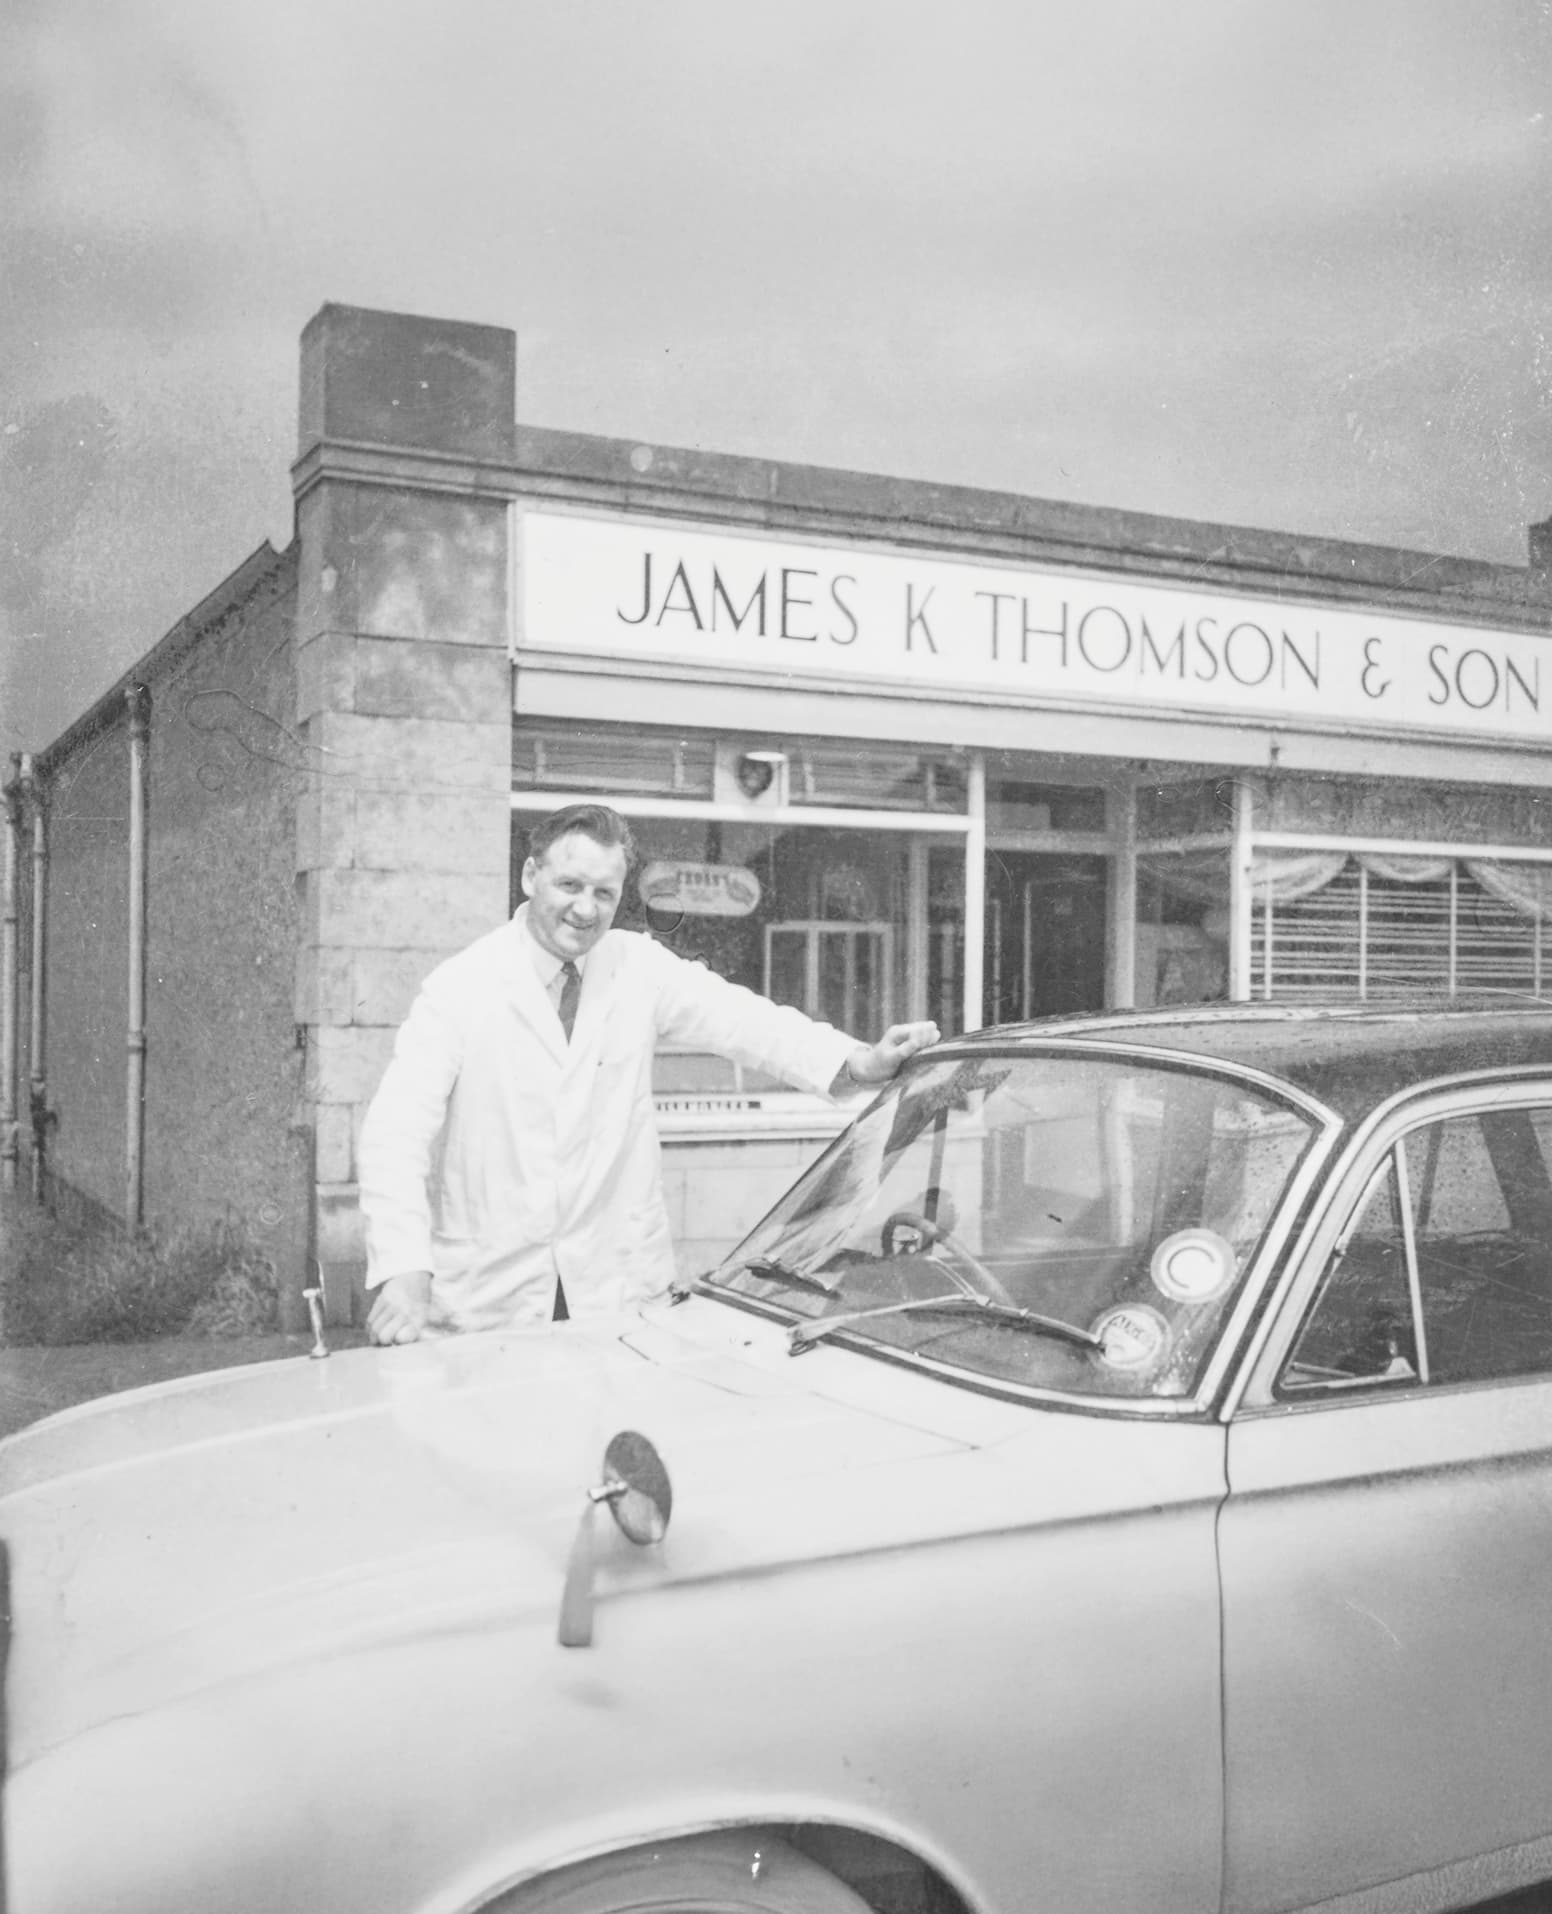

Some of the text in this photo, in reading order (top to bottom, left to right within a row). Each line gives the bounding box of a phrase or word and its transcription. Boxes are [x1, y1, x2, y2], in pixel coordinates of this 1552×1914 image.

[616, 552, 1540, 713] JAMES K THOMSON & SON
